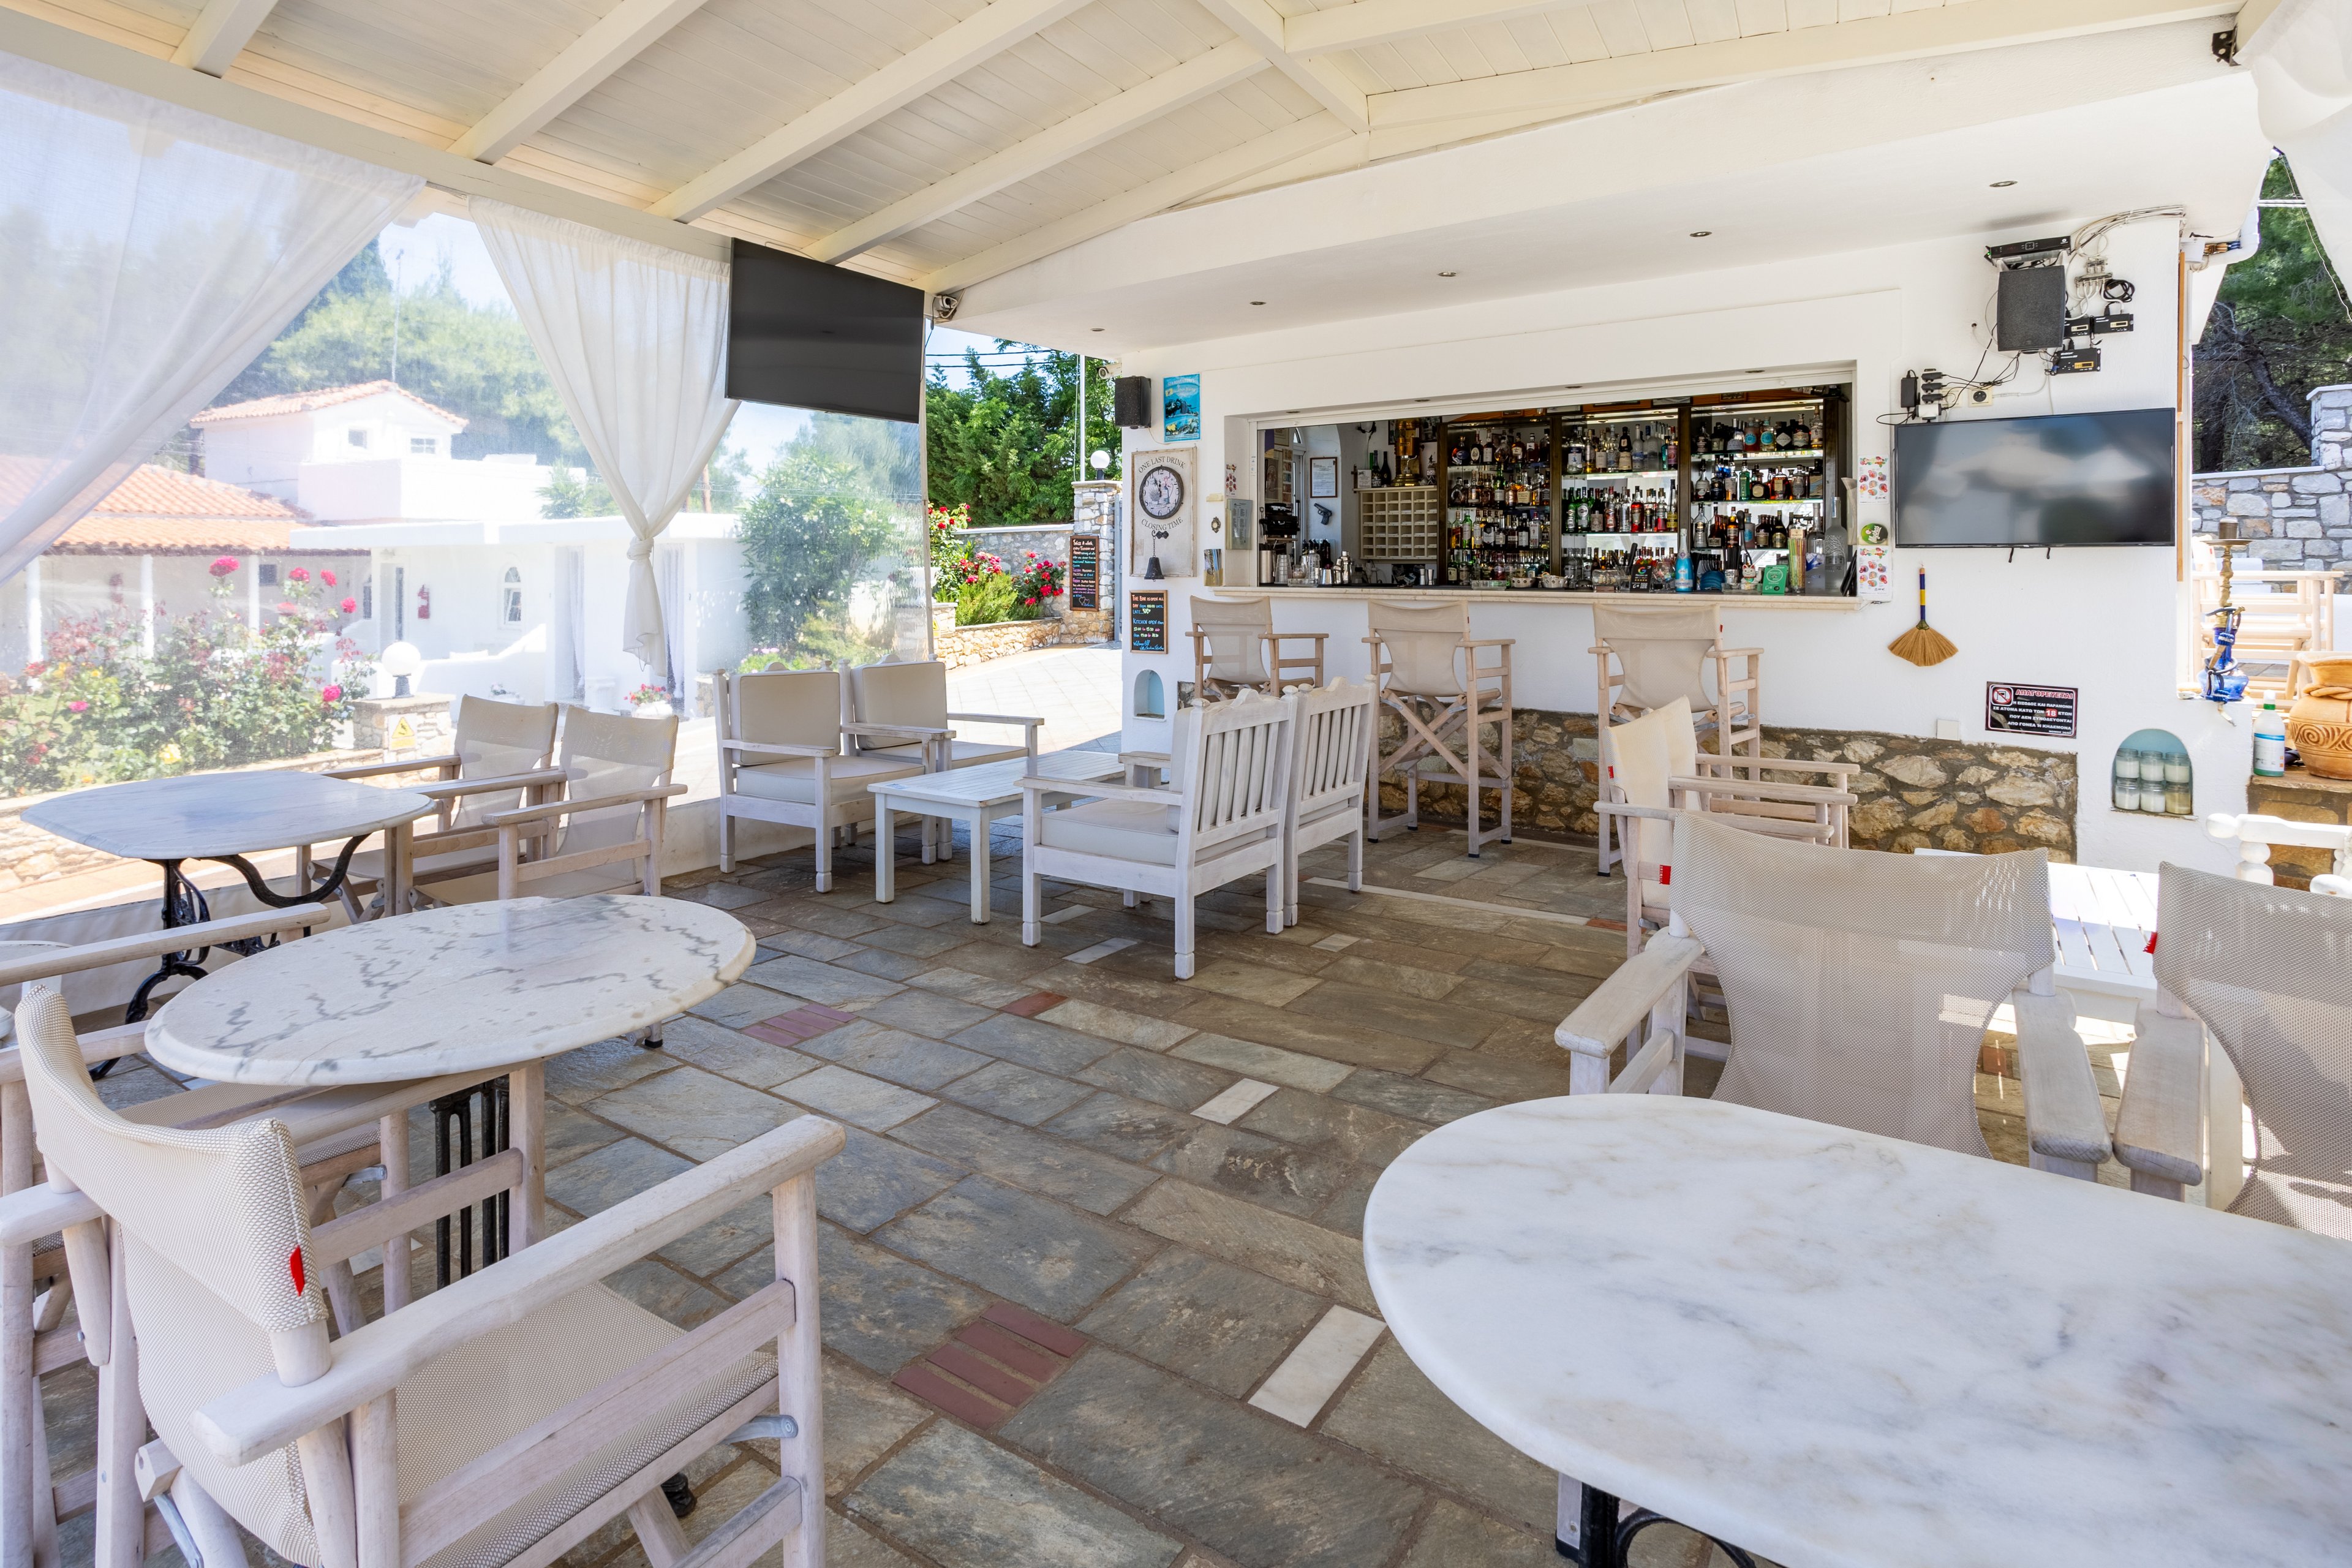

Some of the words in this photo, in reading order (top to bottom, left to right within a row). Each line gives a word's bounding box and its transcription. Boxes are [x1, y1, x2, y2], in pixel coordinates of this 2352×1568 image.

[1139, 461, 1150, 473] ONE
[1152, 456, 1165, 465] LAST
[1166, 456, 1186, 469] DRINK
[1142, 519, 1166, 530] CLOSING
[1167, 517, 1183, 529] TIME
[1868, 526, 1882, 543] Mythos
[2015, 689, 2073, 699] ΑΠΑΓΟΡΕΥΕΤΑΙ
